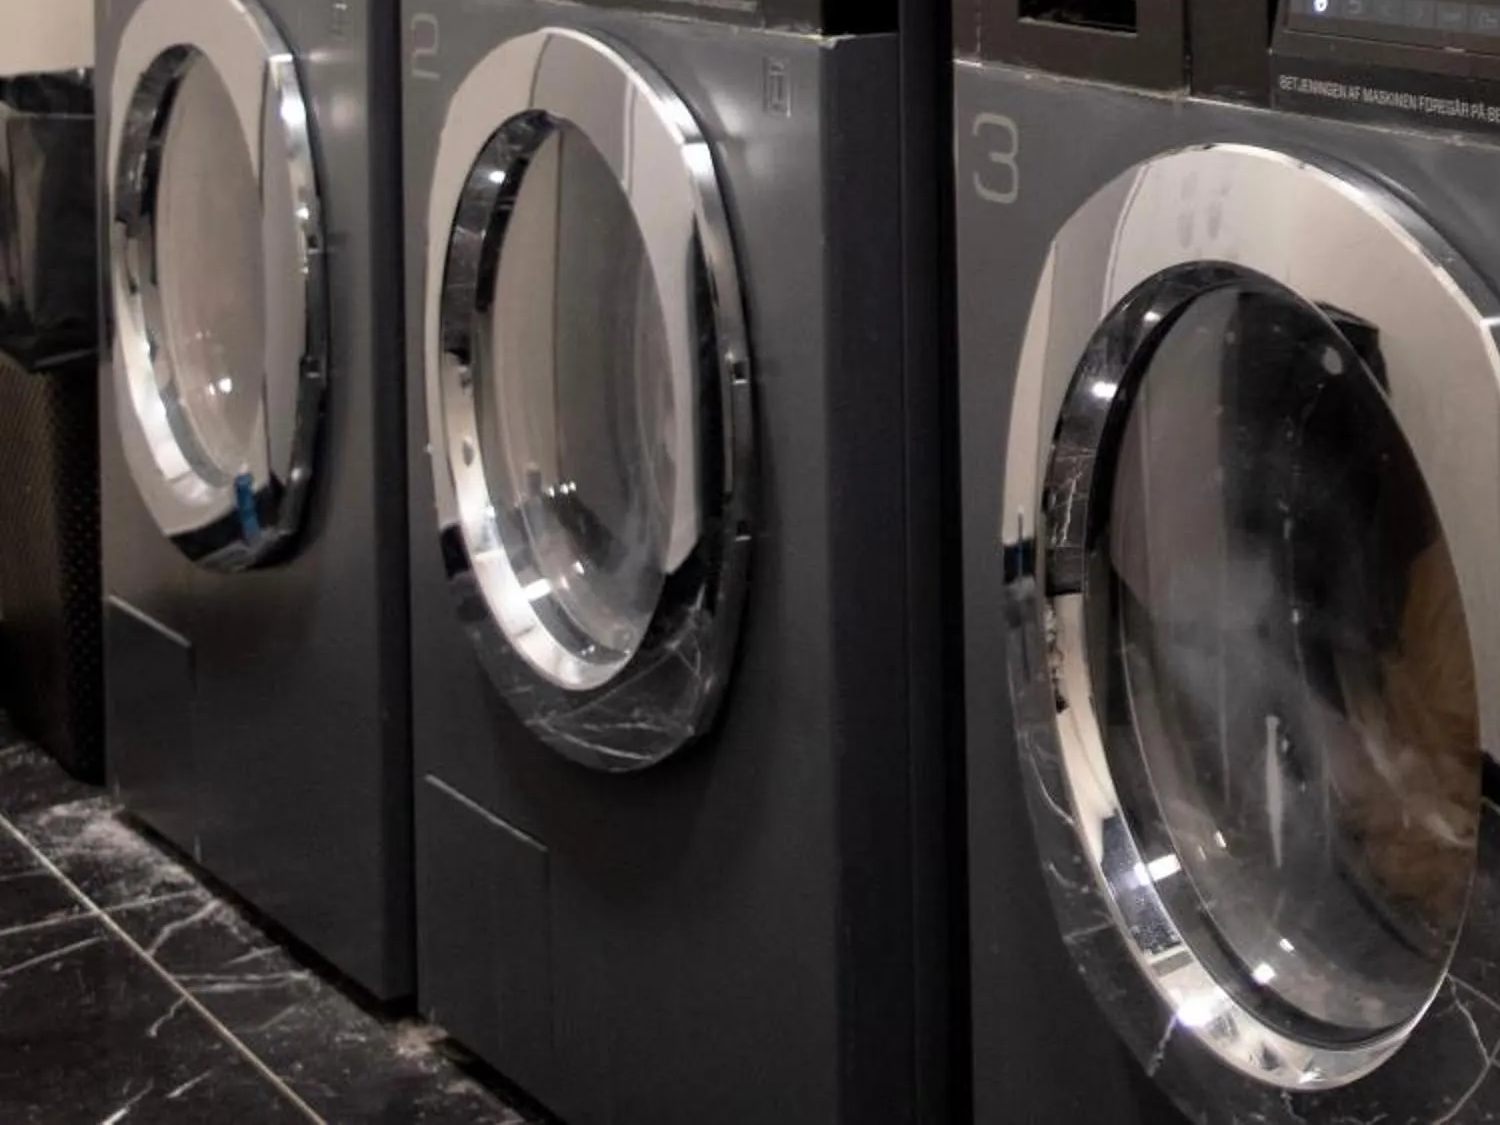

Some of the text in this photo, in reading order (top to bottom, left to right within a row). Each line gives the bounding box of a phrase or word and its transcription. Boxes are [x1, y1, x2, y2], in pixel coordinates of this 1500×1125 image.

[410, 12, 440, 80] 2
[1363, 87, 1417, 111] MASKINEN
[1471, 103, 1486, 120] PÅ
[972, 112, 1019, 205] 3
